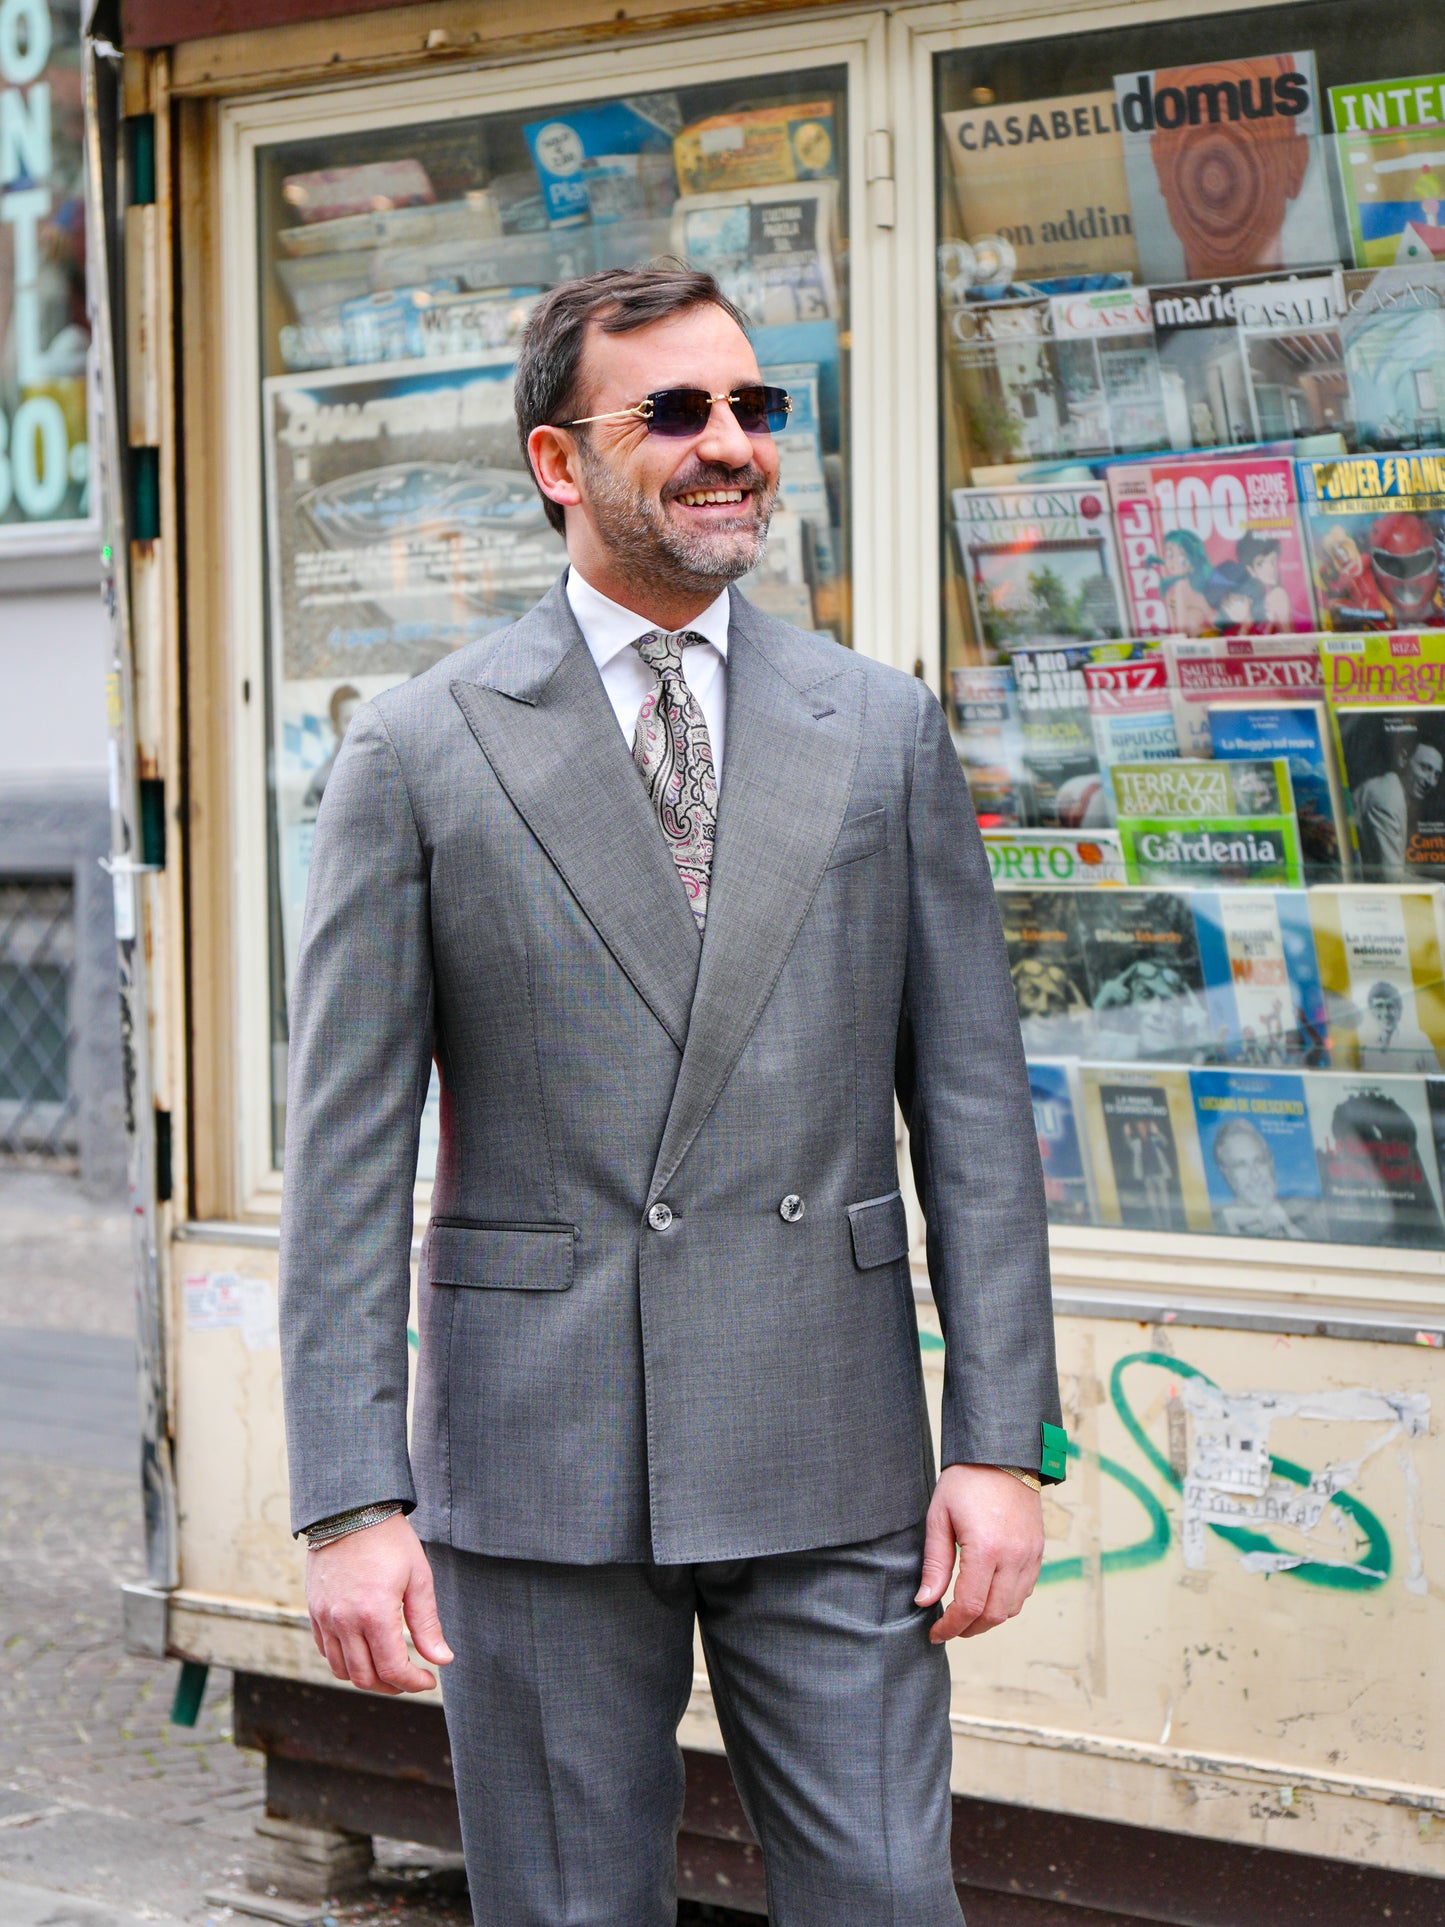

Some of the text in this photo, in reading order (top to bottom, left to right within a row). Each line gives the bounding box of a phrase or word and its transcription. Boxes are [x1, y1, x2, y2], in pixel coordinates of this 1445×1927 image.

[1122, 72, 1310, 133] domus
[1042, 206, 1133, 244] addin
[1311, 459, 1384, 499] POWER
[1155, 474, 1248, 541] 100
[1243, 660, 1324, 687] EXTRA
[1116, 771, 1228, 795] TERRAZZI
[1141, 832, 1277, 864] Gardenia
